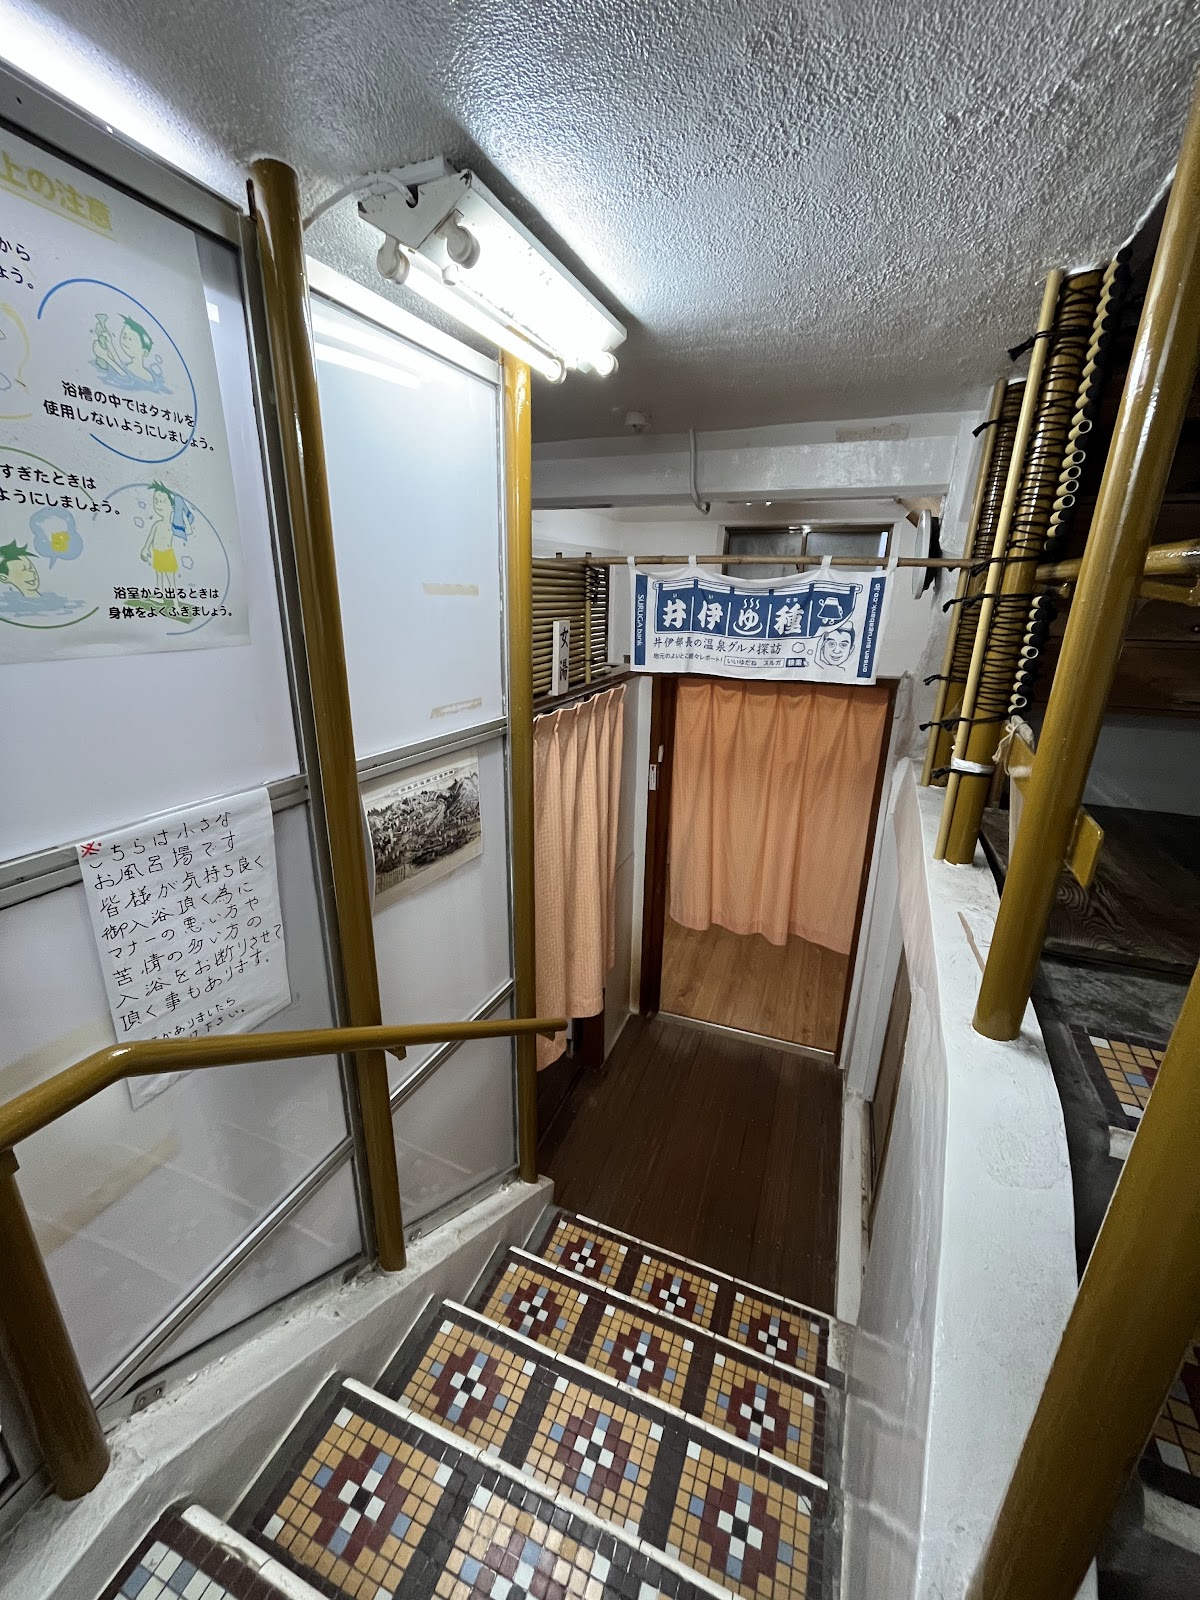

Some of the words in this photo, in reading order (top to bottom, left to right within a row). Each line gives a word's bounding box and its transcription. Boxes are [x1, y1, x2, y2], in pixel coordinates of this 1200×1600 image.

[43, 399, 215, 451] 使用しないようにしましょう。
[61, 380, 195, 428] 浴槽の中ではタオルを
[0, 463, 97, 490] すぎたときは
[109, 605, 233, 619] 身体をよくふきましょう。
[113, 586, 219, 600] 浴室から出るときは
[560, 626, 569, 681] 女湯
[653, 636, 782, 655] 井伊部長の温泉グルメ探訪
[862, 583, 881, 673] onsen.surugabank.co.jp
[94, 831, 236, 890] お風呂場です
[100, 855, 265, 918] 皆様が気持ち良く
[101, 880, 253, 940] 御入浴頂く為に
[108, 897, 259, 959] マナーの悪い方や
[113, 915, 262, 986] 苦情の多い方の
[116, 924, 281, 1009] 入浴をお断りさせて
